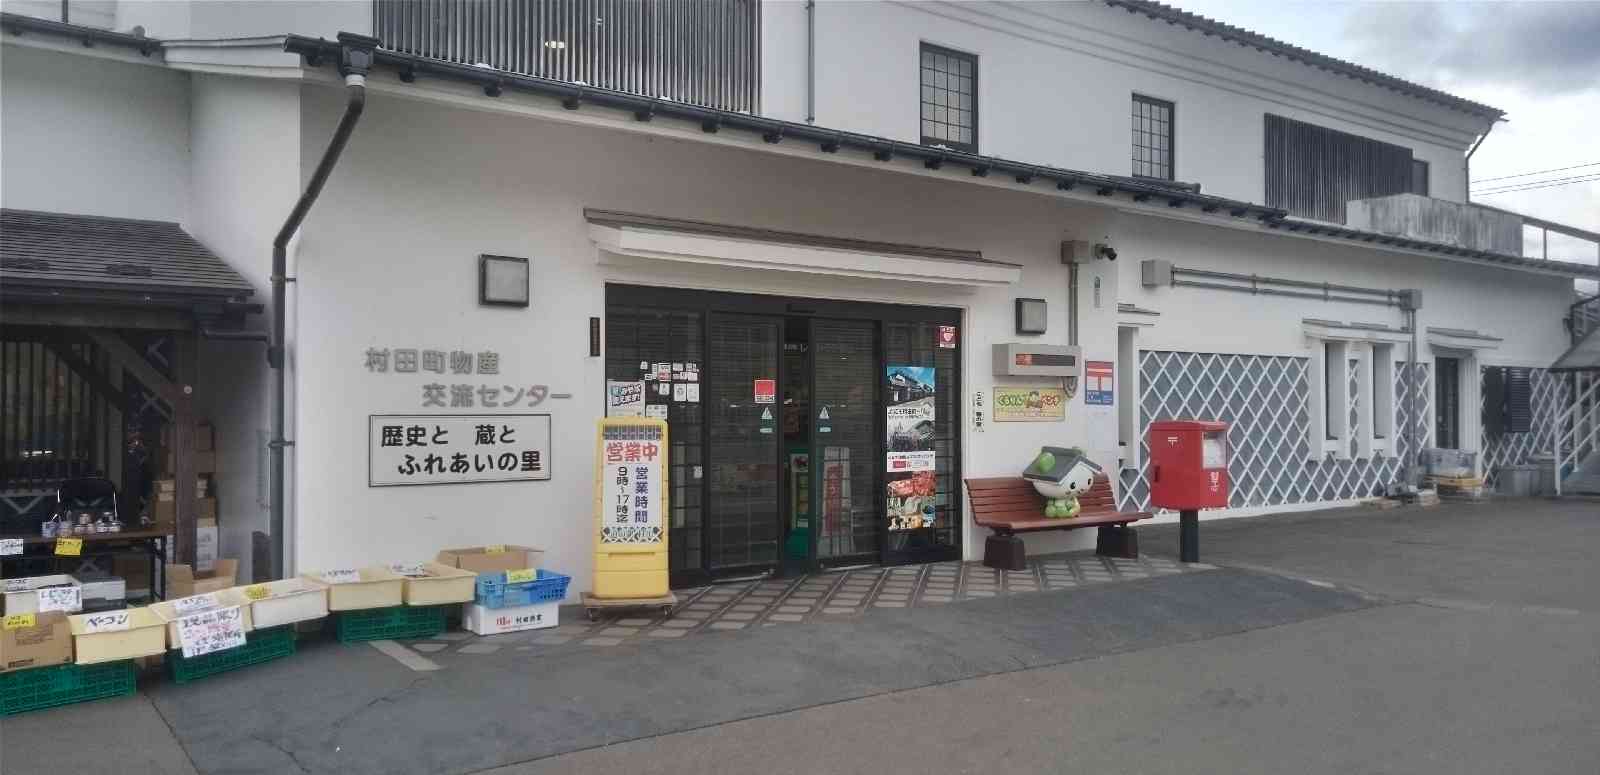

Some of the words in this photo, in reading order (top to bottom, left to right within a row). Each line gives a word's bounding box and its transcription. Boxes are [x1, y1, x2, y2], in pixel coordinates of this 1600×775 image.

[365, 348, 500, 375] 村田町物産
[421, 383, 573, 408] 交流センター
[381, 424, 449, 448] 歴史と
[474, 424, 516, 446] 蔵と
[397, 450, 542, 476] ふれあいの里
[606, 442, 658, 464] 営業中
[635, 466, 649, 524] 営業時間
